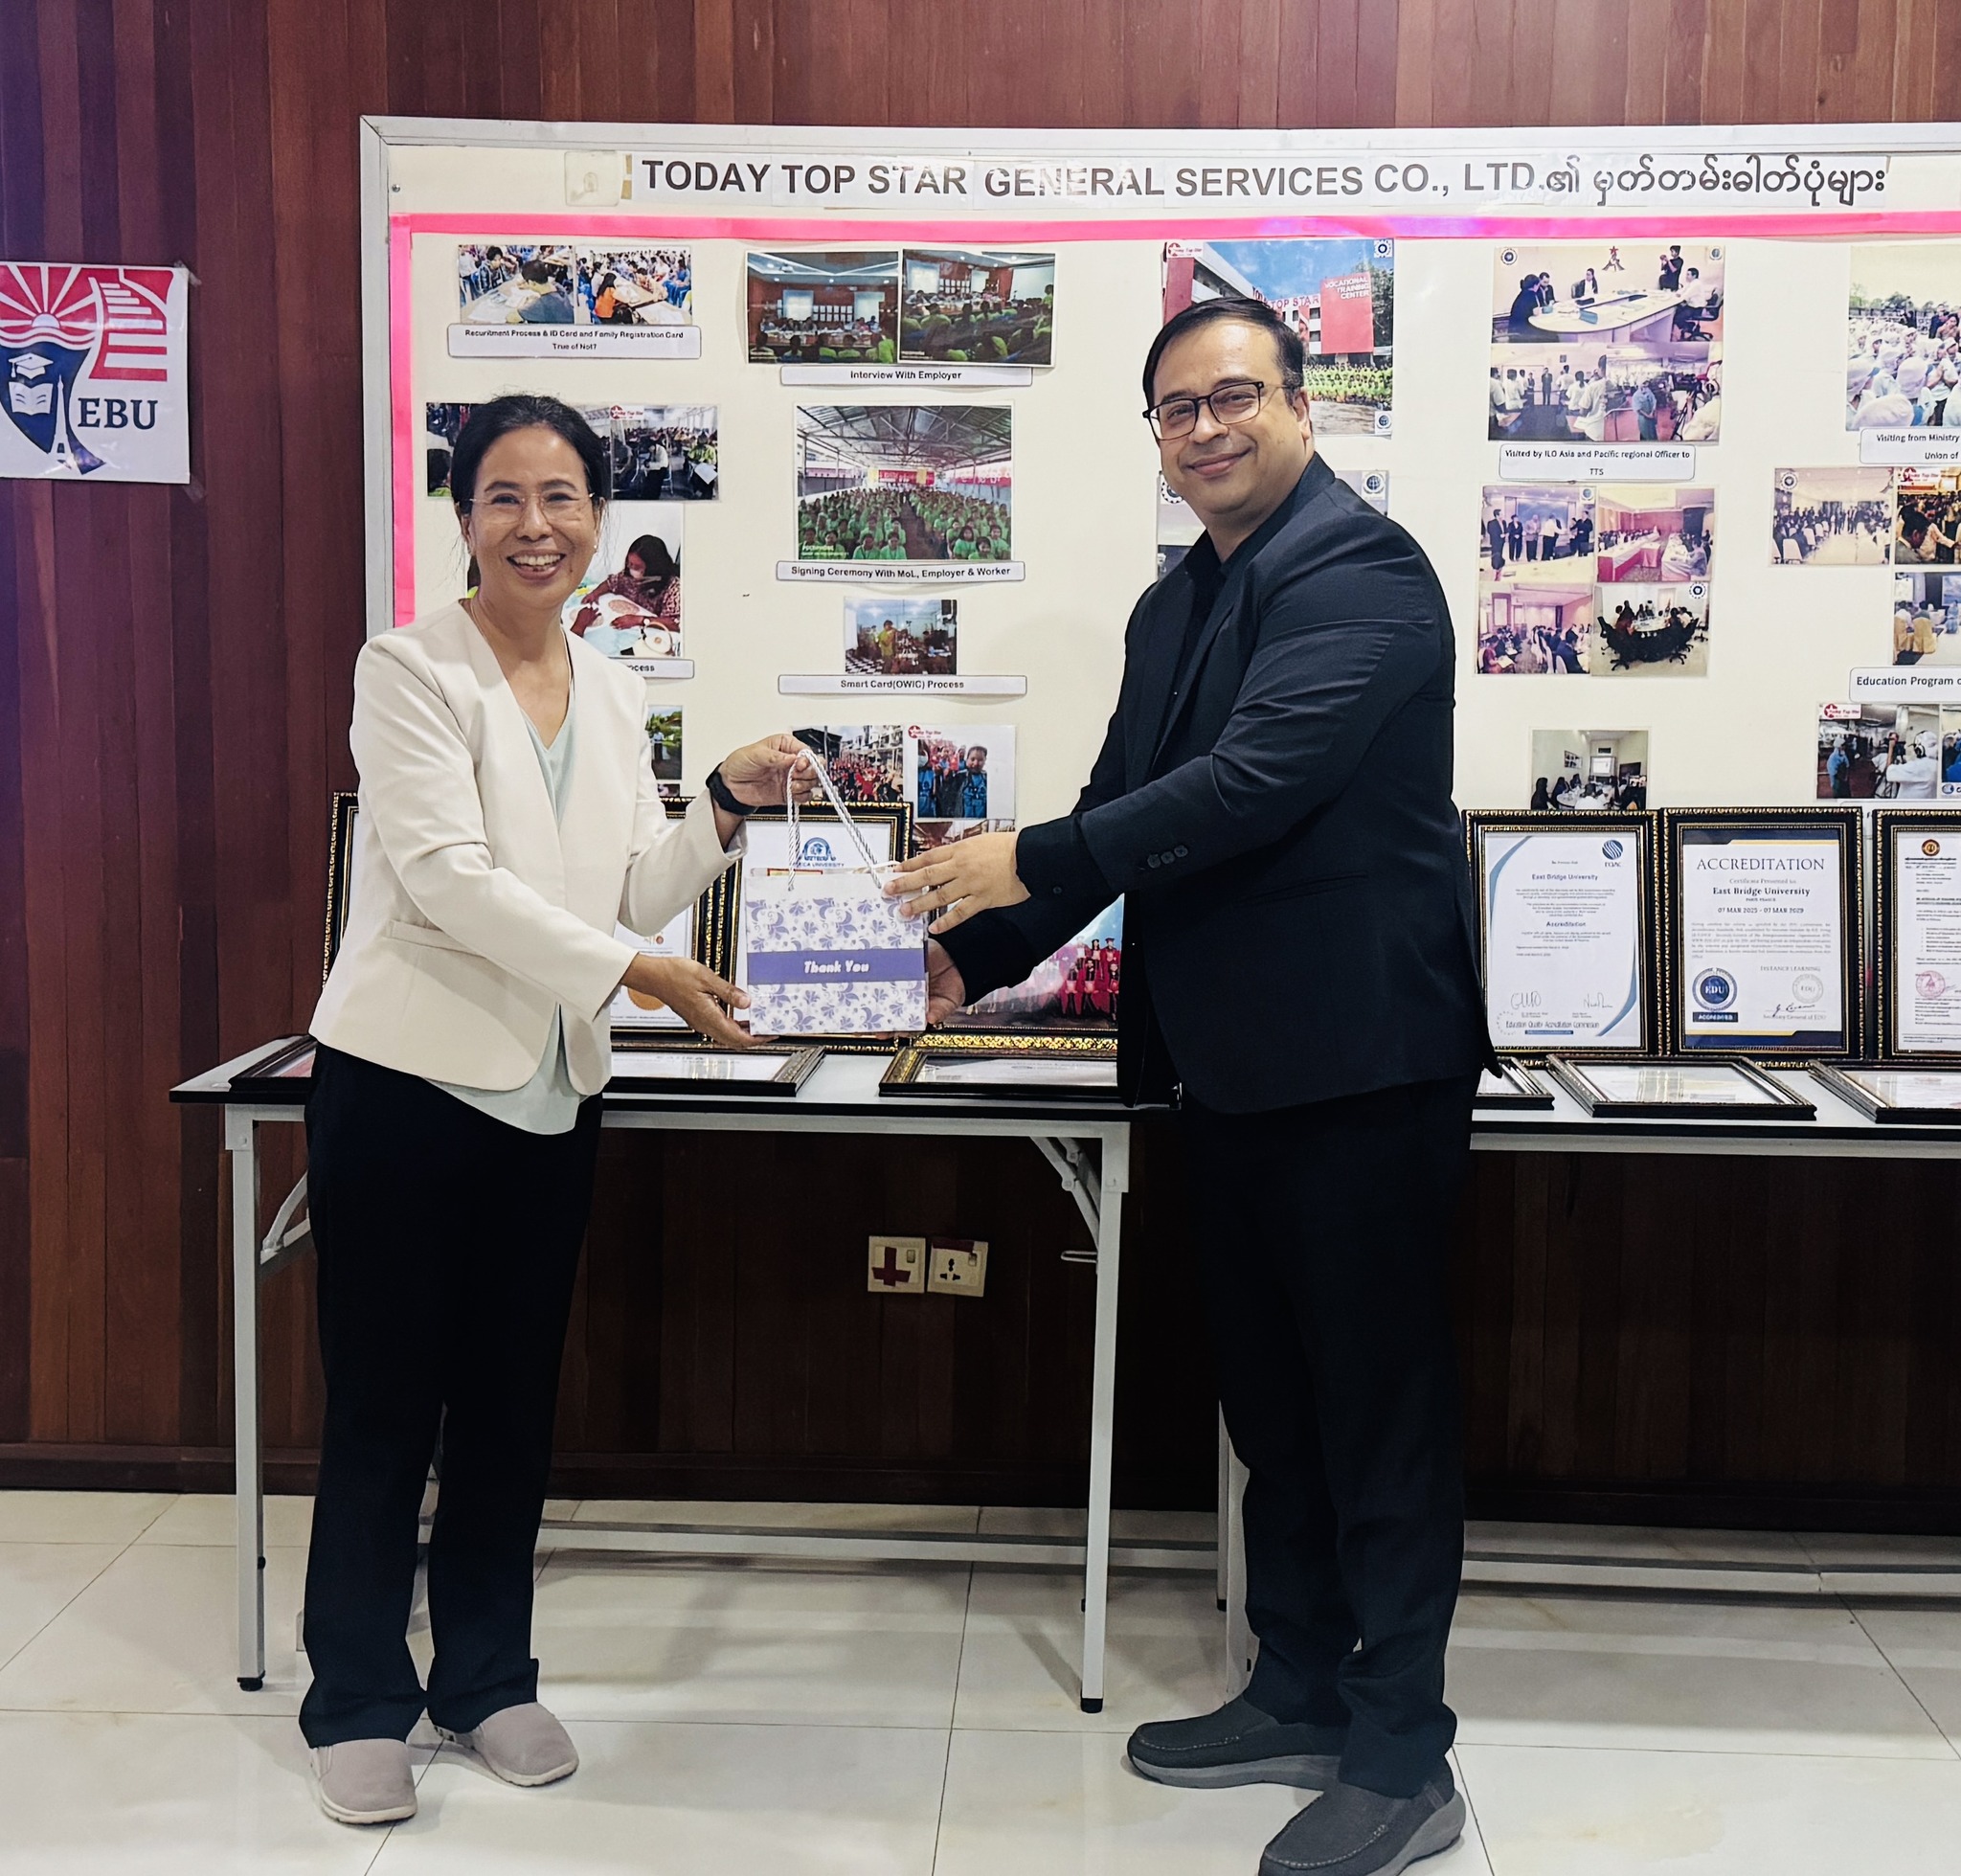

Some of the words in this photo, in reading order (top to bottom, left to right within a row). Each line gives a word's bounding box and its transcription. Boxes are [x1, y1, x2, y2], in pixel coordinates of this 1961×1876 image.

[642, 160, 771, 192] TODAY
[781, 165, 855, 193] TOP
[868, 165, 967, 194] STAR
[984, 168, 1165, 196] GENERAL
[1176, 166, 1364, 197] SERVICES
[1374, 164, 1449, 197] CO.,
[1341, 290, 1370, 300] CENTER
[1293, 295, 1319, 307] STAR
[850, 371, 893, 379] Interview
[895, 371, 916, 379] With
[918, 371, 962, 381] Employer
[78, 396, 159, 431] EBU
[1877, 434, 1905, 443] Visiting
[1928, 434, 1960, 443] Ministry
[1505, 449, 1531, 458] Visited
[1532, 449, 1543, 459] by
[1621, 450, 1653, 460] regional
[1589, 467, 1604, 476] TTS
[791, 566, 825, 576] Signing
[827, 567, 873, 578] Ceremony
[897, 569, 919, 578] MoL,
[921, 569, 965, 578] Employer
[967, 568, 975, 576] &
[977, 567, 1011, 576] Worker
[841, 679, 868, 689] Smart
[870, 679, 925, 689] Card(OWIC)
[927, 680, 964, 689] Process
[1857, 676, 1907, 686] Education
[1910, 676, 1954, 688] Program
[1697, 858, 1825, 870] ACCREDITATION
[1733, 887, 1762, 896] Bridge
[1764, 887, 1811, 896] University
[804, 960, 842, 974] Thank
[845, 960, 869, 973] You
[1704, 985, 1724, 995] EDU
